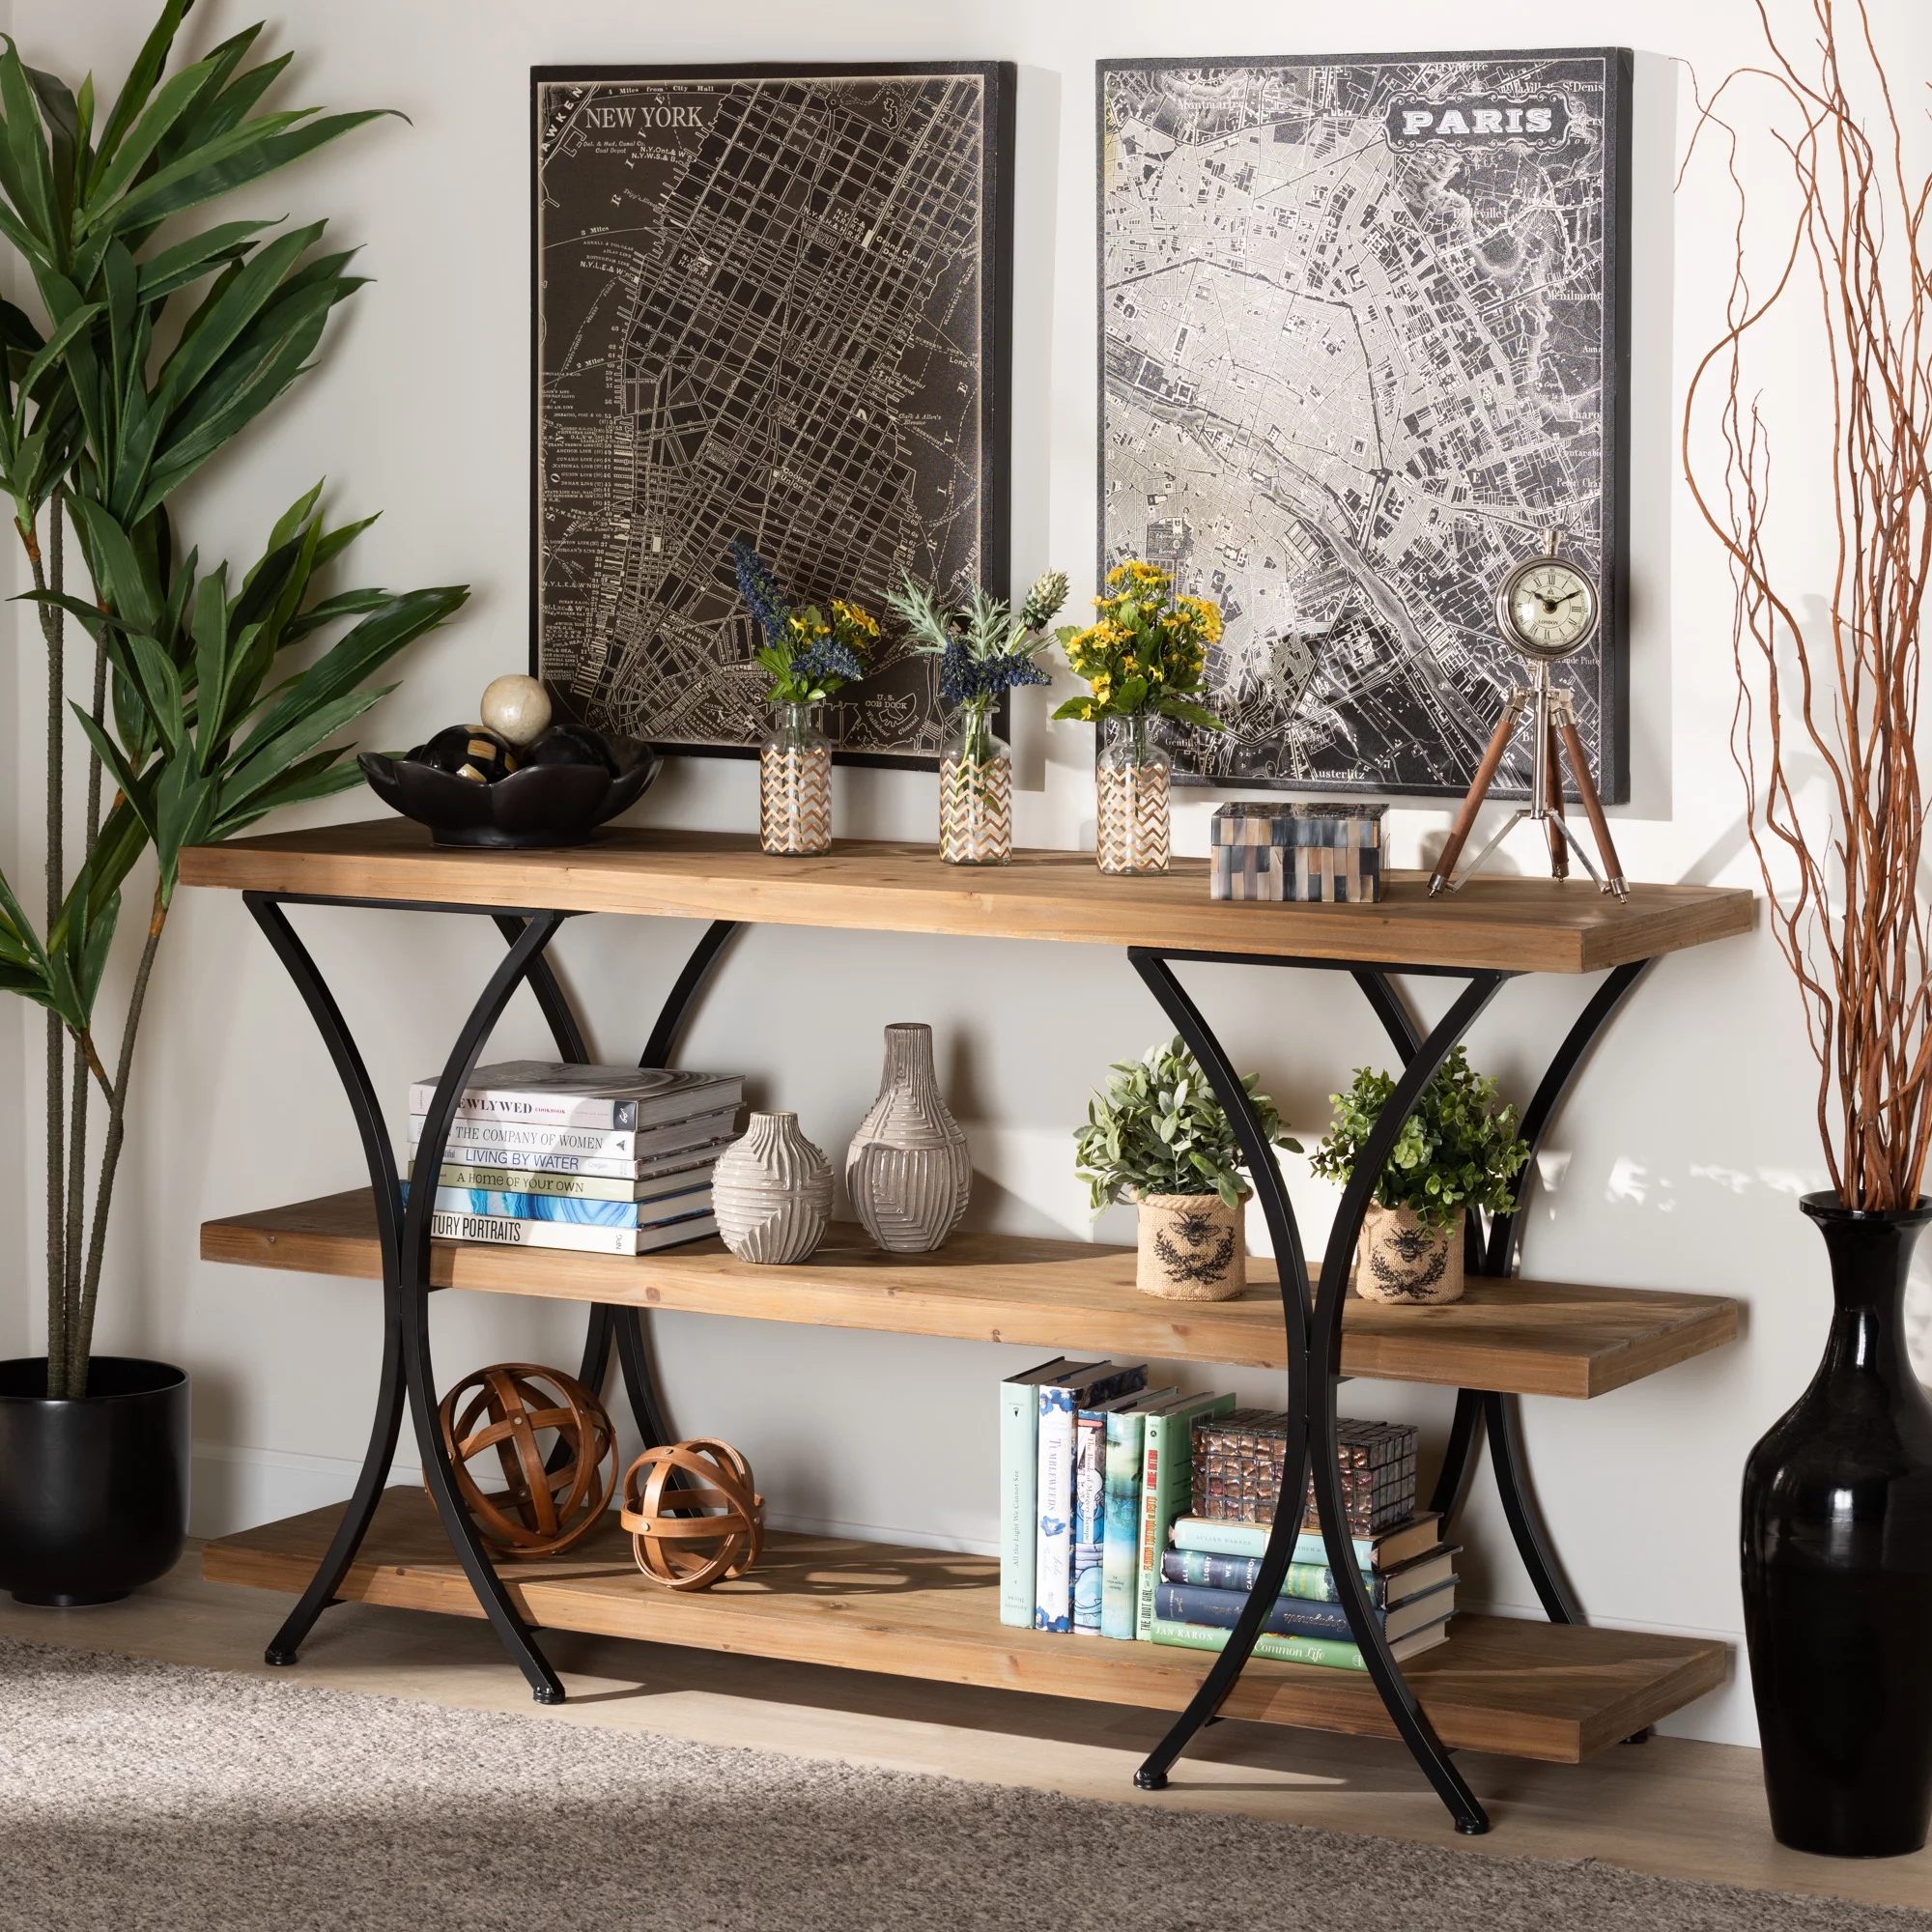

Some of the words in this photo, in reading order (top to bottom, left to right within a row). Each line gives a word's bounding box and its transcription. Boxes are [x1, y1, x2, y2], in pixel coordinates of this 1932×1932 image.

[586, 108, 636, 128] NEW
[641, 107, 703, 128] YORK
[1403, 107, 1552, 135] PARIS
[907, 123, 927, 154] CENTRAL
[883, 248, 907, 264] Depot
[584, 358, 604, 367] Miles
[950, 357, 968, 367] Long
[895, 382, 915, 395] Morgue
[902, 375, 925, 389] Hospital
[781, 474, 803, 491] Union
[782, 467, 812, 489] Cooper
[566, 521, 580, 532] Mile
[898, 715, 920, 735] Channel
[457, 1097, 532, 1114] EWLYWED
[456, 1127, 479, 1140] THE
[483, 1128, 538, 1146] COMPANY
[540, 1133, 555, 1146] OF
[559, 1136, 604, 1150] WOMEN
[466, 1150, 508, 1165] LIVING
[512, 1153, 529, 1165] BY
[534, 1154, 579, 1170] WATER
[457, 1173, 465, 1182] A
[506, 1177, 520, 1186] OF
[431, 1215, 460, 1236] TURY
[462, 1217, 521, 1241] PORTRAITS
[1086, 1472, 1093, 1481] of
[1085, 1481, 1094, 1513] Margery
[1013, 1509, 1019, 1519] We
[1204, 1556, 1212, 1580] LIGHT
[1225, 1565, 1233, 1577] WE
[1142, 1589, 1153, 1602] GIRL
[1141, 1603, 1152, 1619] IDIOT
[1141, 1620, 1151, 1631] THE
[1155, 1627, 1174, 1635] JAN
[1178, 1630, 1213, 1640] KARON
[1255, 1642, 1302, 1657] Common
[1305, 1647, 1325, 1662] Life
